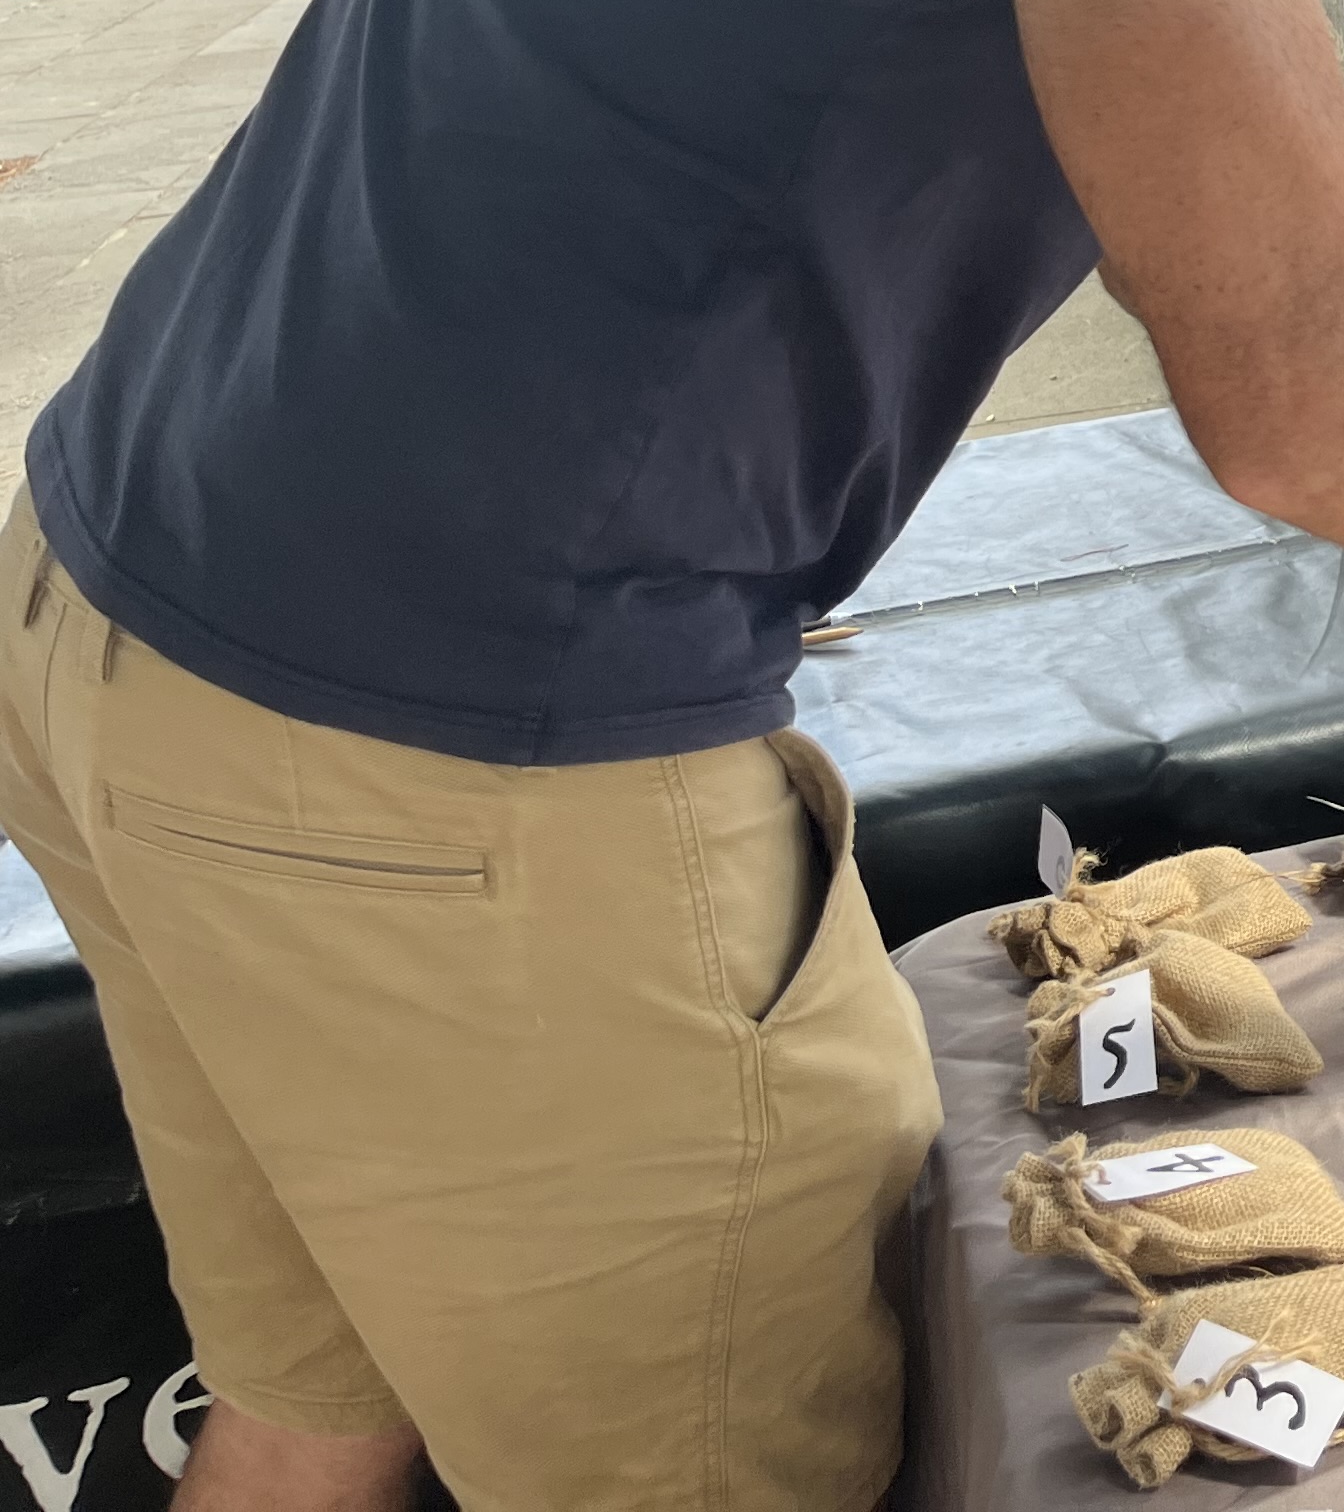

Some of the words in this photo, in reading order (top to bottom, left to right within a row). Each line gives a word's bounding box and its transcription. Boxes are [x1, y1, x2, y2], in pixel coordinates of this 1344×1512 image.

[1101, 1017, 1136, 1090] 5
[1146, 1151, 1226, 1176] 4
[1223, 1364, 1307, 1431] 3
